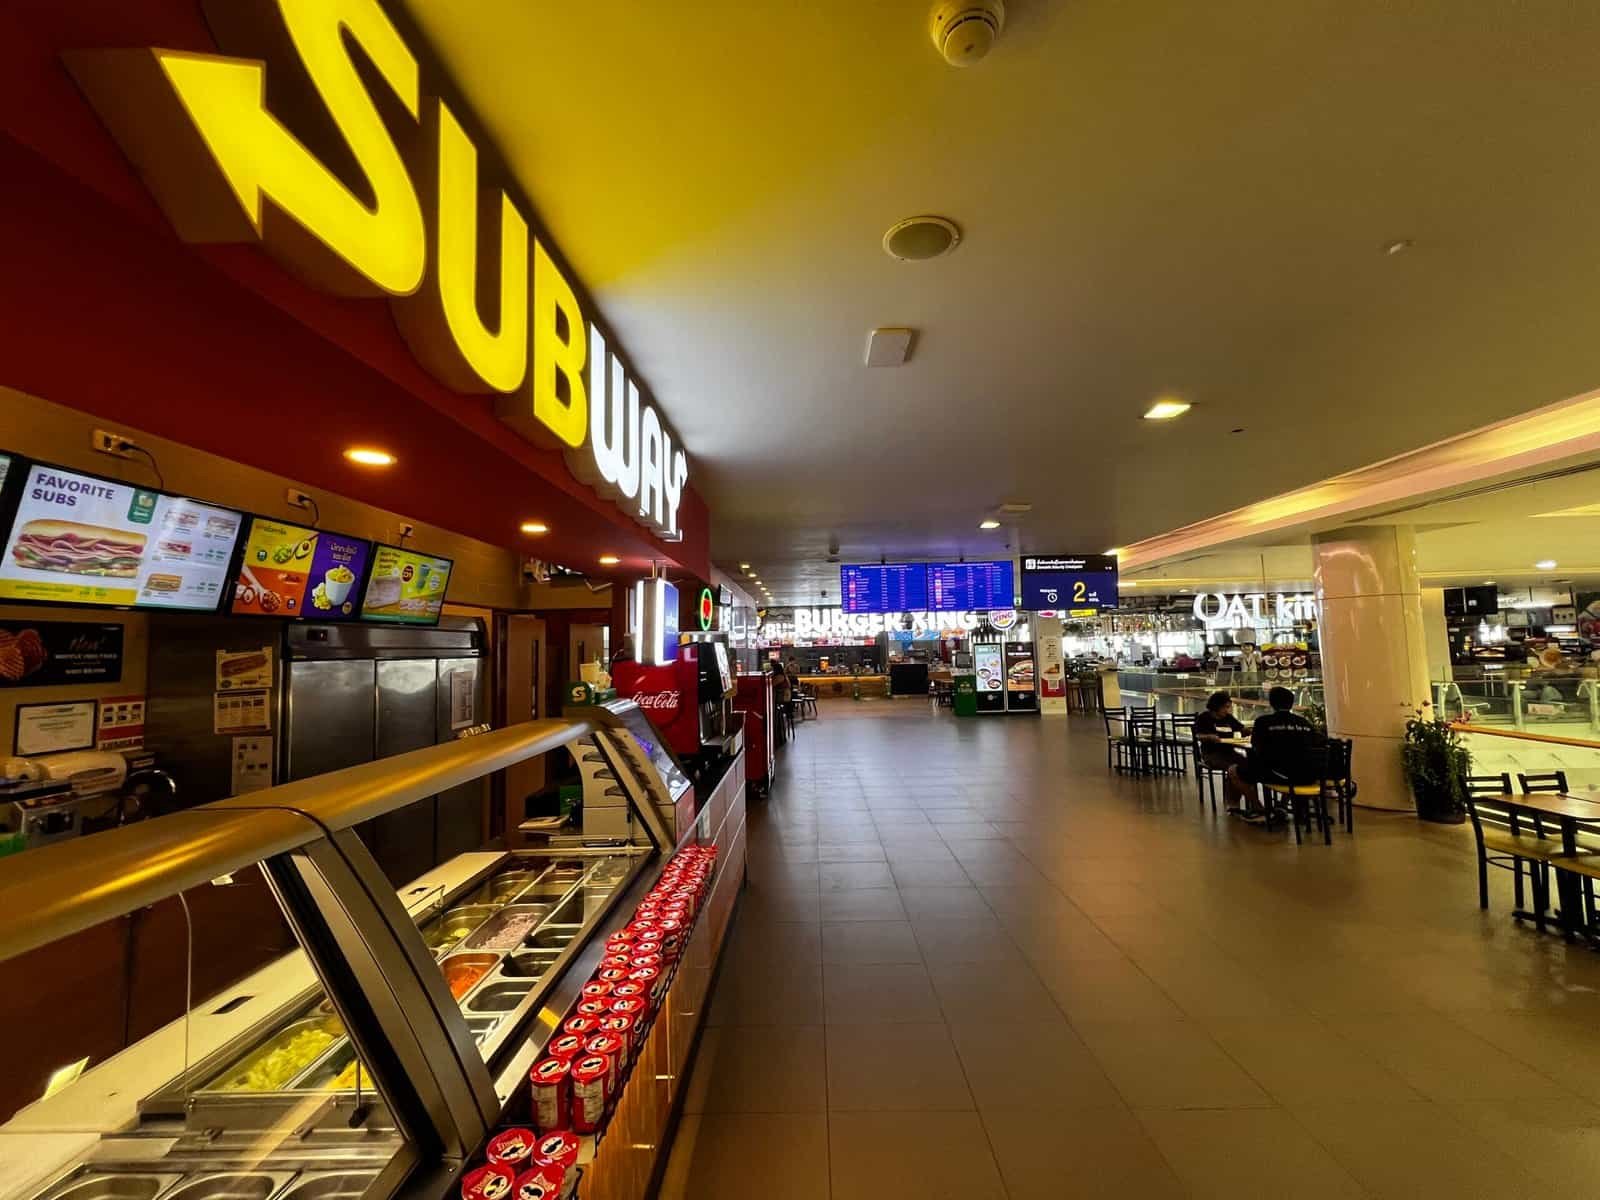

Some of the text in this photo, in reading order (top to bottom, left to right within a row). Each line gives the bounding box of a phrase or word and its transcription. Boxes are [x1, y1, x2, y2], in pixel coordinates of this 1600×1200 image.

[157, 0, 689, 543] SUBWAY
[31, 488, 77, 507] SUBS
[36, 473, 115, 500] FAVORITE
[1073, 581, 1086, 603] 2
[1193, 592, 1315, 621] OAT kit
[794, 608, 902, 634] BURGER
[631, 690, 681, 709] Coca-Cola
